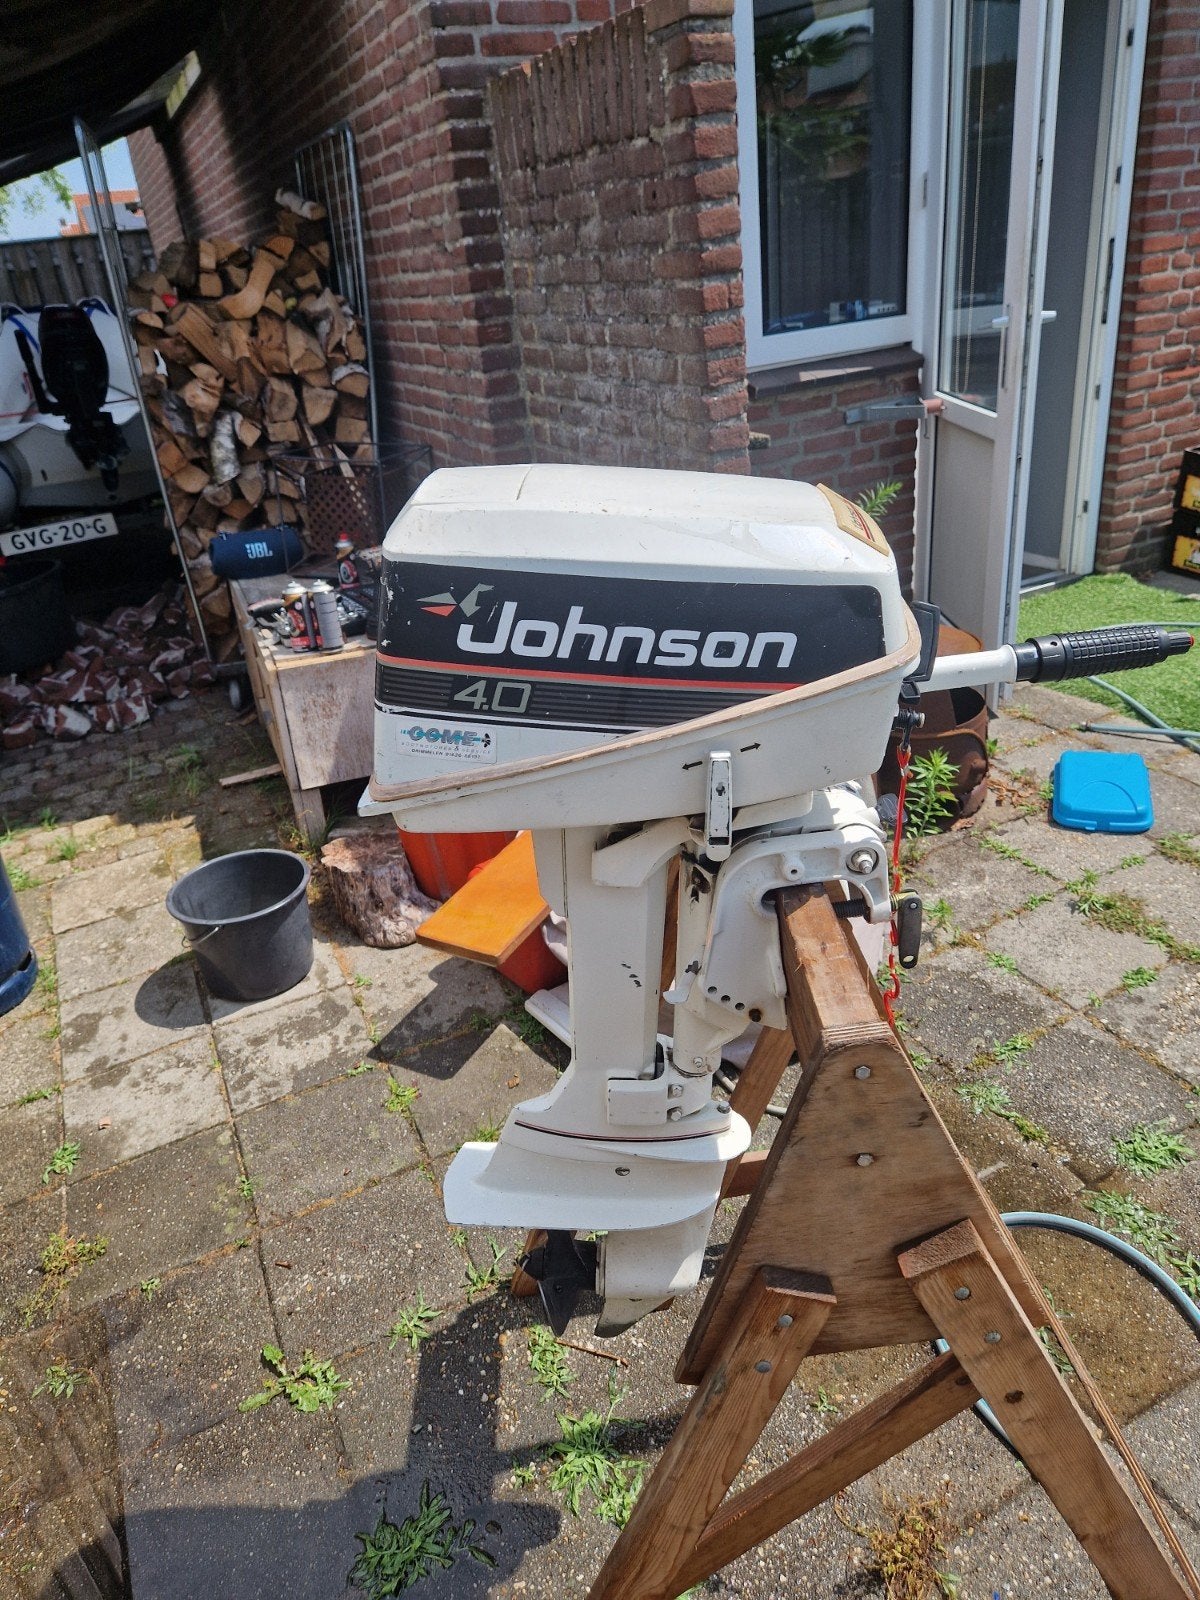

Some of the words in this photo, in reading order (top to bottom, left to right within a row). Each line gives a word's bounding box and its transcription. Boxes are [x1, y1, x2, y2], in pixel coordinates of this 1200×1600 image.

[11, 518, 107, 550] GVG-20-G
[245, 541, 273, 559] JBL
[456, 601, 798, 668] Johnson
[453, 679, 532, 714] 4.0
